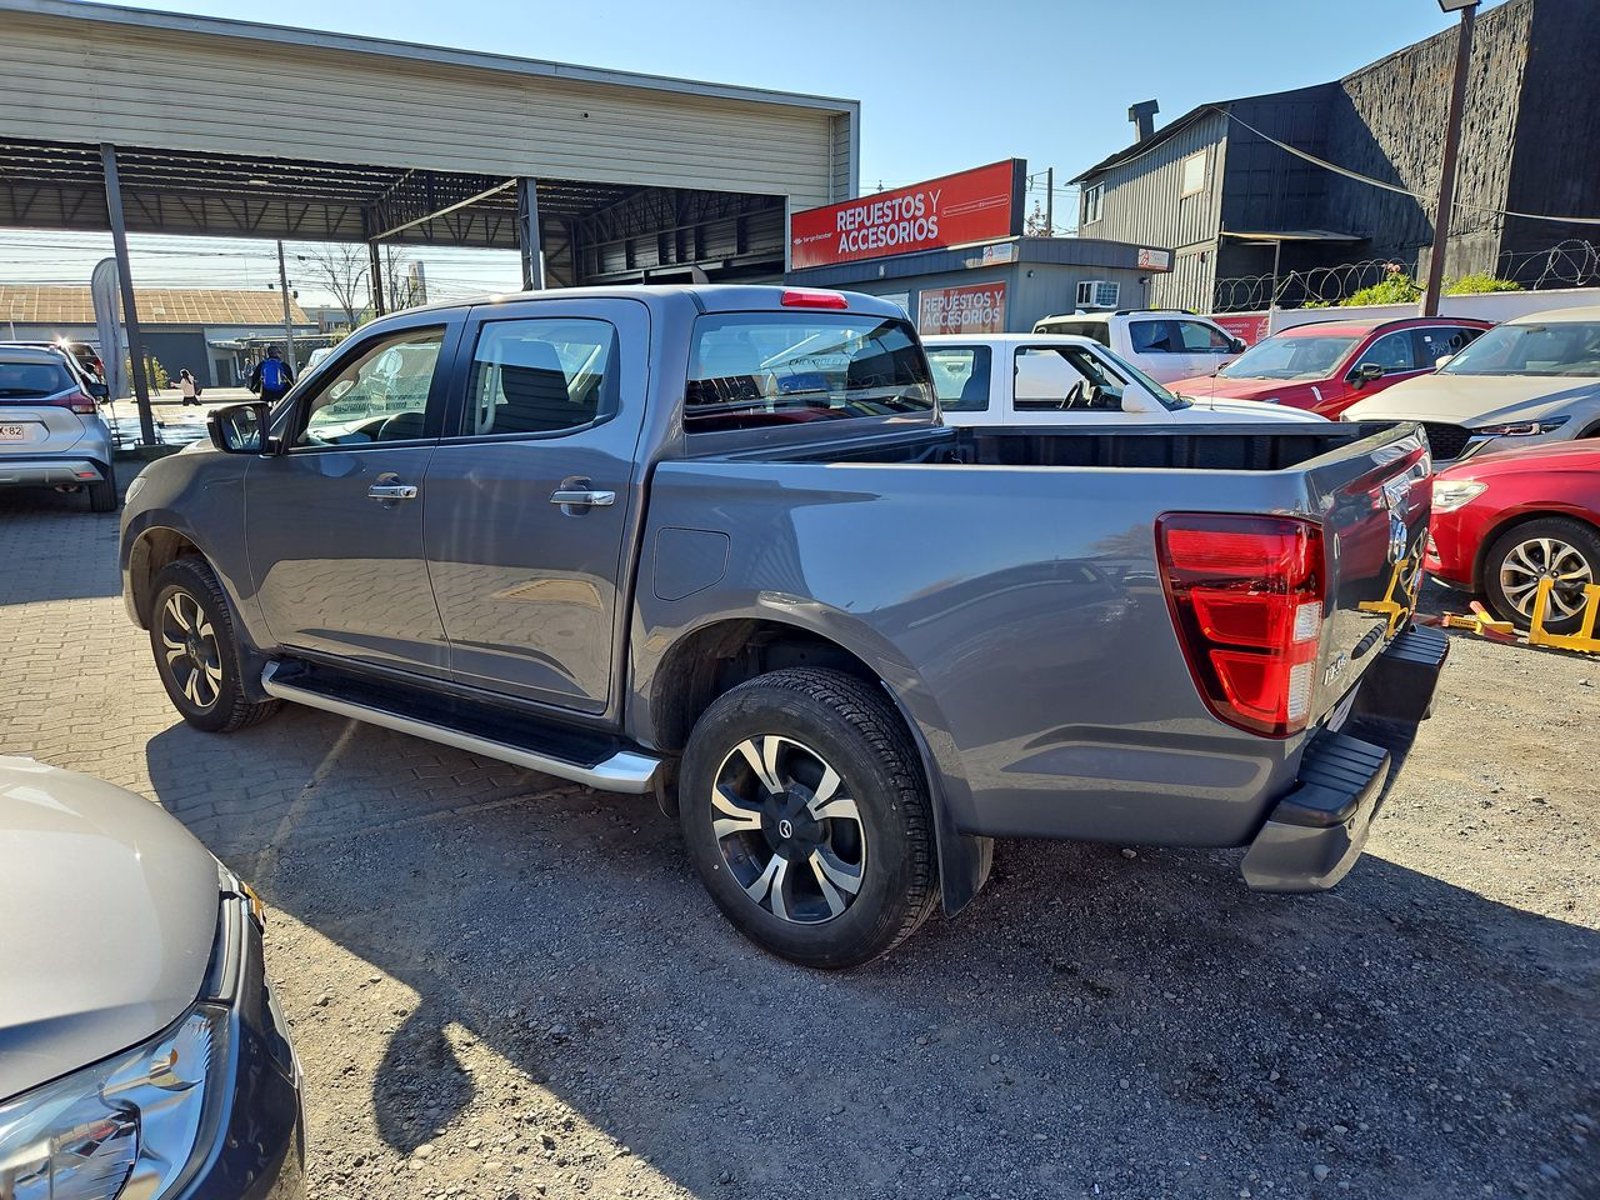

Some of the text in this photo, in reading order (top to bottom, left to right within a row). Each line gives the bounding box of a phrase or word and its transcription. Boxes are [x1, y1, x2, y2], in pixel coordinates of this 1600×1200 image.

[837, 193, 925, 232] REPUESTOS
[929, 189, 941, 213] Y
[838, 215, 938, 254] ACCESORIOS
[923, 290, 1004, 313] REPUESTOS Y
[924, 307, 1000, 328] ACCESORIOS
